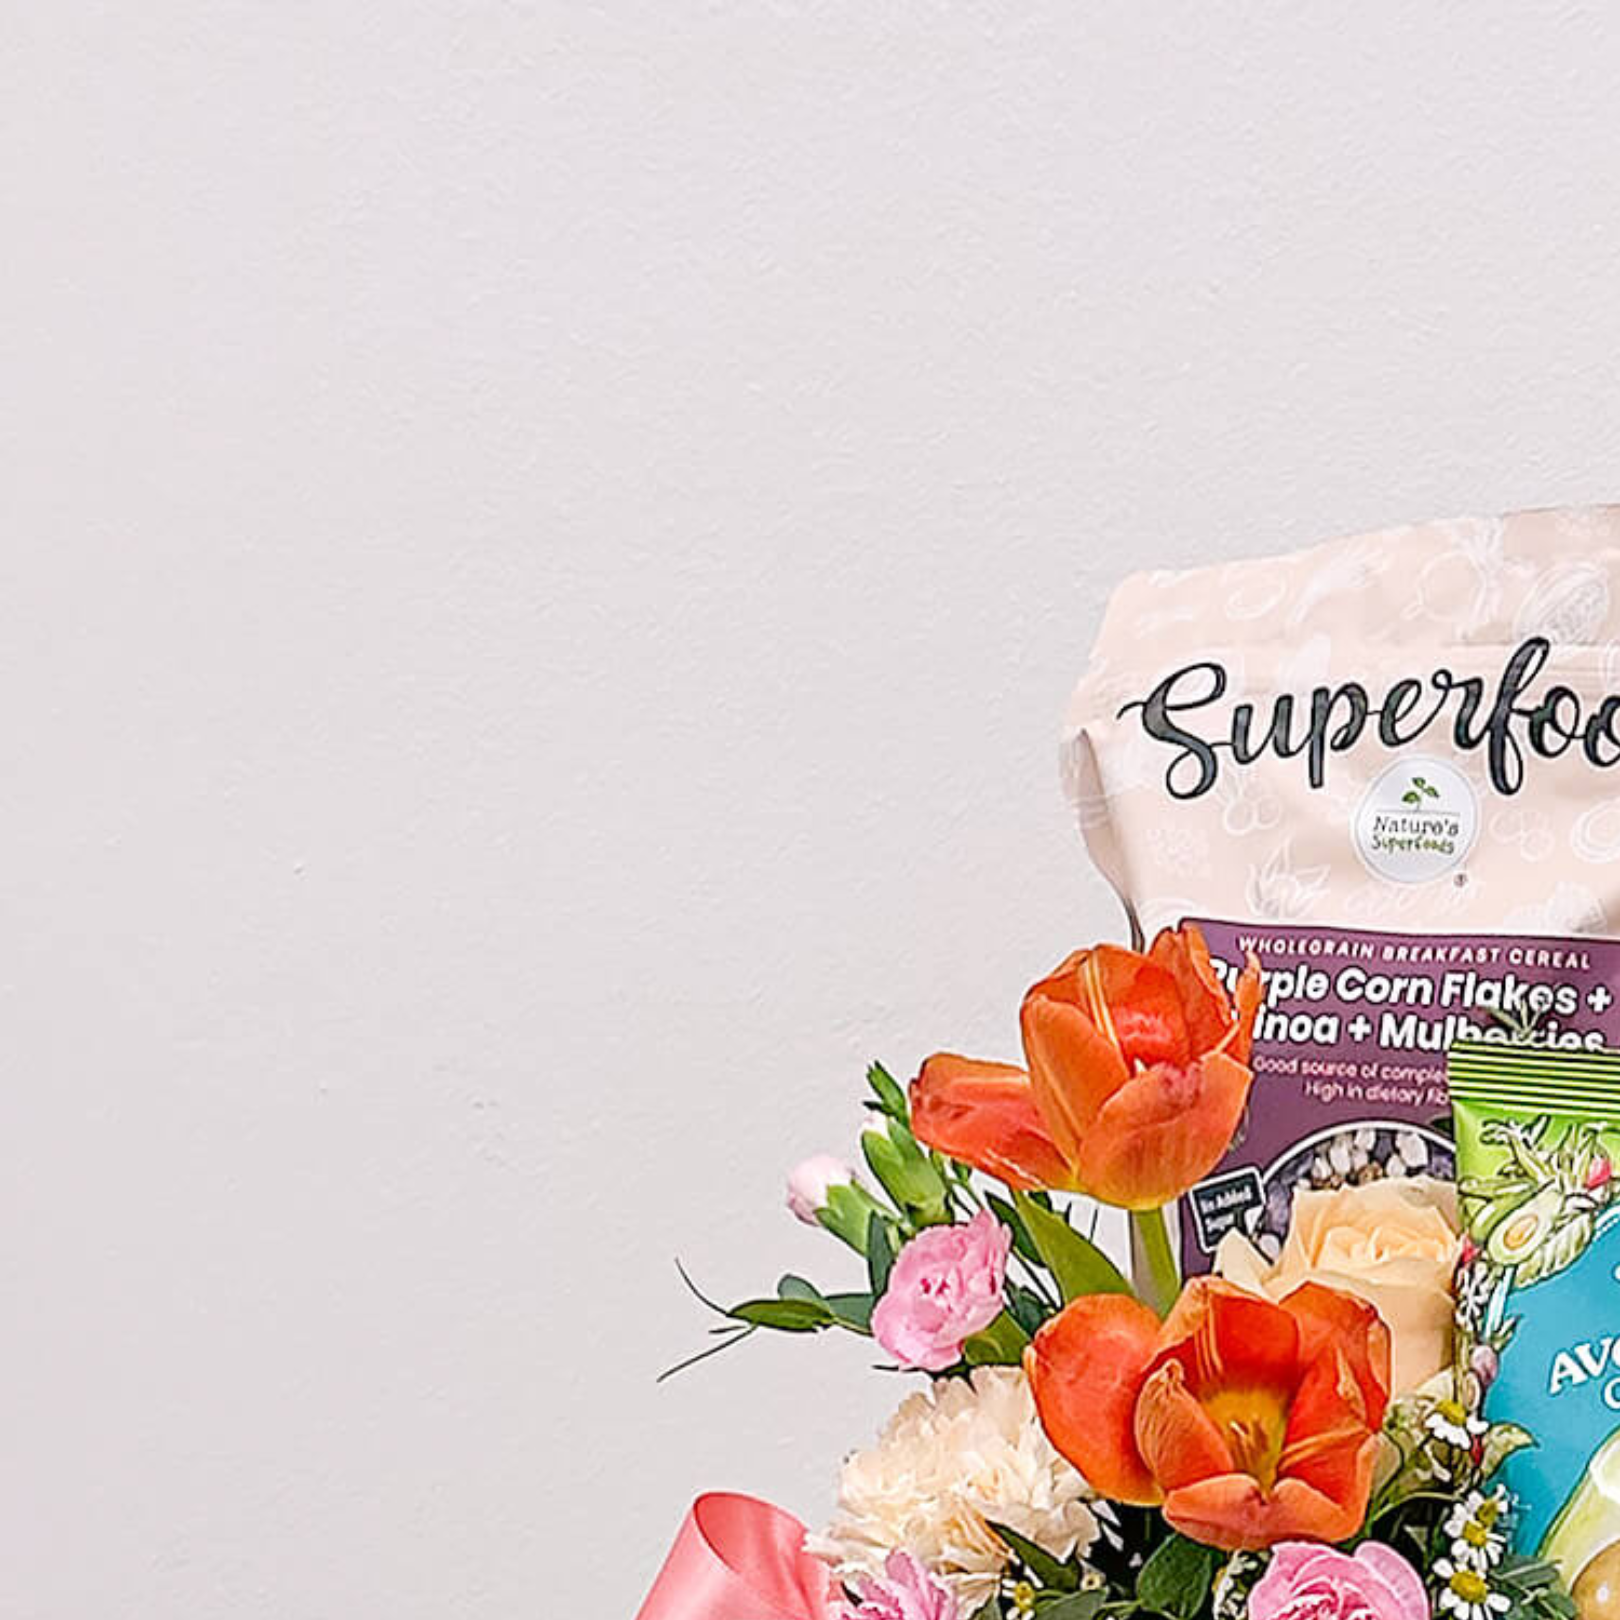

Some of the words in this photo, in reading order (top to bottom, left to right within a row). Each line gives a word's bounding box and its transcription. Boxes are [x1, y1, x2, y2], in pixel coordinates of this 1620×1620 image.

[1237, 936, 1375, 959] WHOLEGRAIN
[1381, 944, 1501, 965] BREAKFAST
[1509, 948, 1591, 970] CEREAL
[1335, 966, 1434, 1006] Corn
[1440, 970, 1579, 1015] Flakes
[1586, 985, 1613, 1013] +
[1347, 1016, 1372, 1043] +
[1252, 1055, 1299, 1075] Good
[1301, 1061, 1358, 1077] source
[1361, 1062, 1379, 1080] of
[1304, 1080, 1345, 1103] High
[1347, 1083, 1364, 1098] in
[1365, 1084, 1424, 1107] dietary
